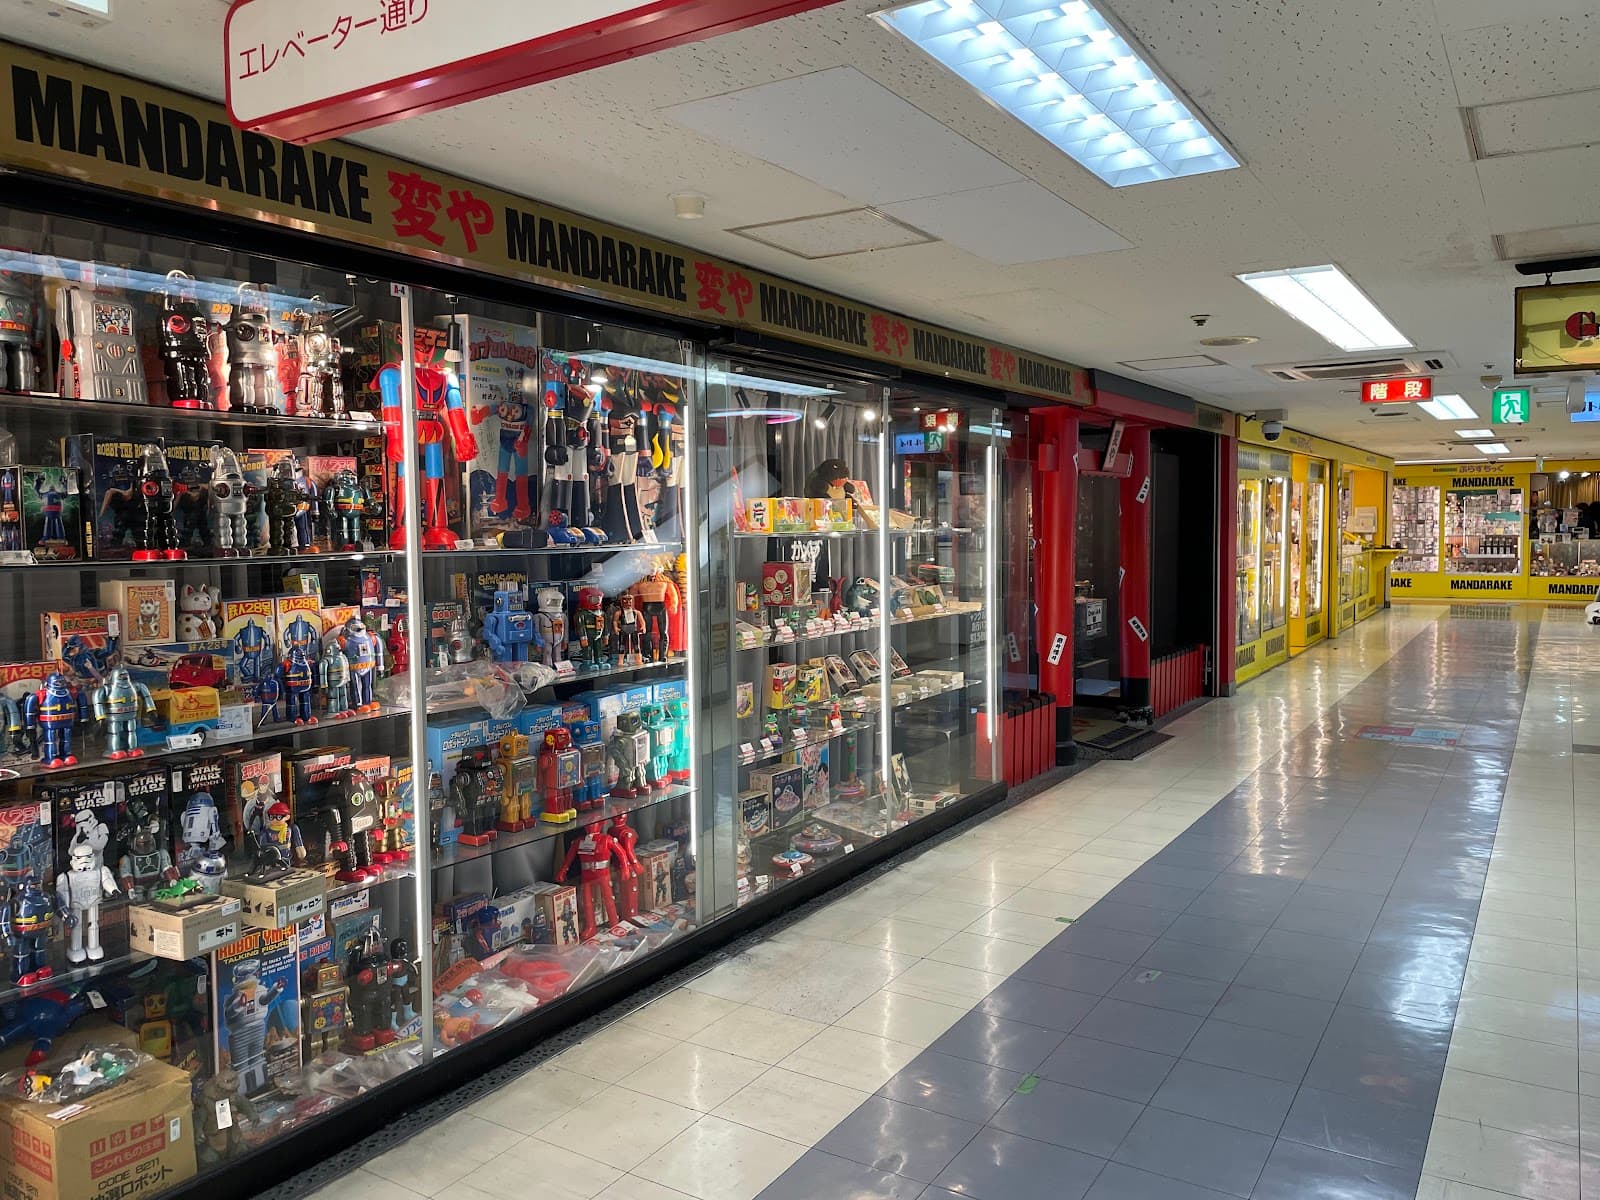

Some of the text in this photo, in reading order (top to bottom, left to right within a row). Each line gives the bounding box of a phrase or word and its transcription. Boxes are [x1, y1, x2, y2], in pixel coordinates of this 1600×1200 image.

[11, 64, 372, 225] MANDARAKE
[388, 169, 495, 254] 変や
[505, 207, 687, 302] MANDARAKE
[694, 260, 754, 319] 変や
[759, 282, 868, 347] MANDARAKE
[870, 313, 909, 356] 変や
[913, 327, 987, 375] MANDARAKE
[1018, 357, 1072, 395] MANDARAKE
[1370, 381, 1423, 400] 階段
[1452, 476, 1514, 487] MANDARAKE
[1451, 579, 1513, 590] MANDARAKE
[228, 601, 272, 620] 鉄人28号
[280, 597, 318, 614] 鉄人28号
[190, 765, 222, 776] STAR
[190, 771, 222, 783] WARS
[130, 774, 167, 788] STAR
[78, 789, 105, 801] STA
[128, 782, 167, 797] WARS
[75, 798, 105, 810] WAR
[218, 931, 261, 960] ROBOT
[223, 950, 260, 965] TALKING
[98, 1169, 130, 1190] CODE
